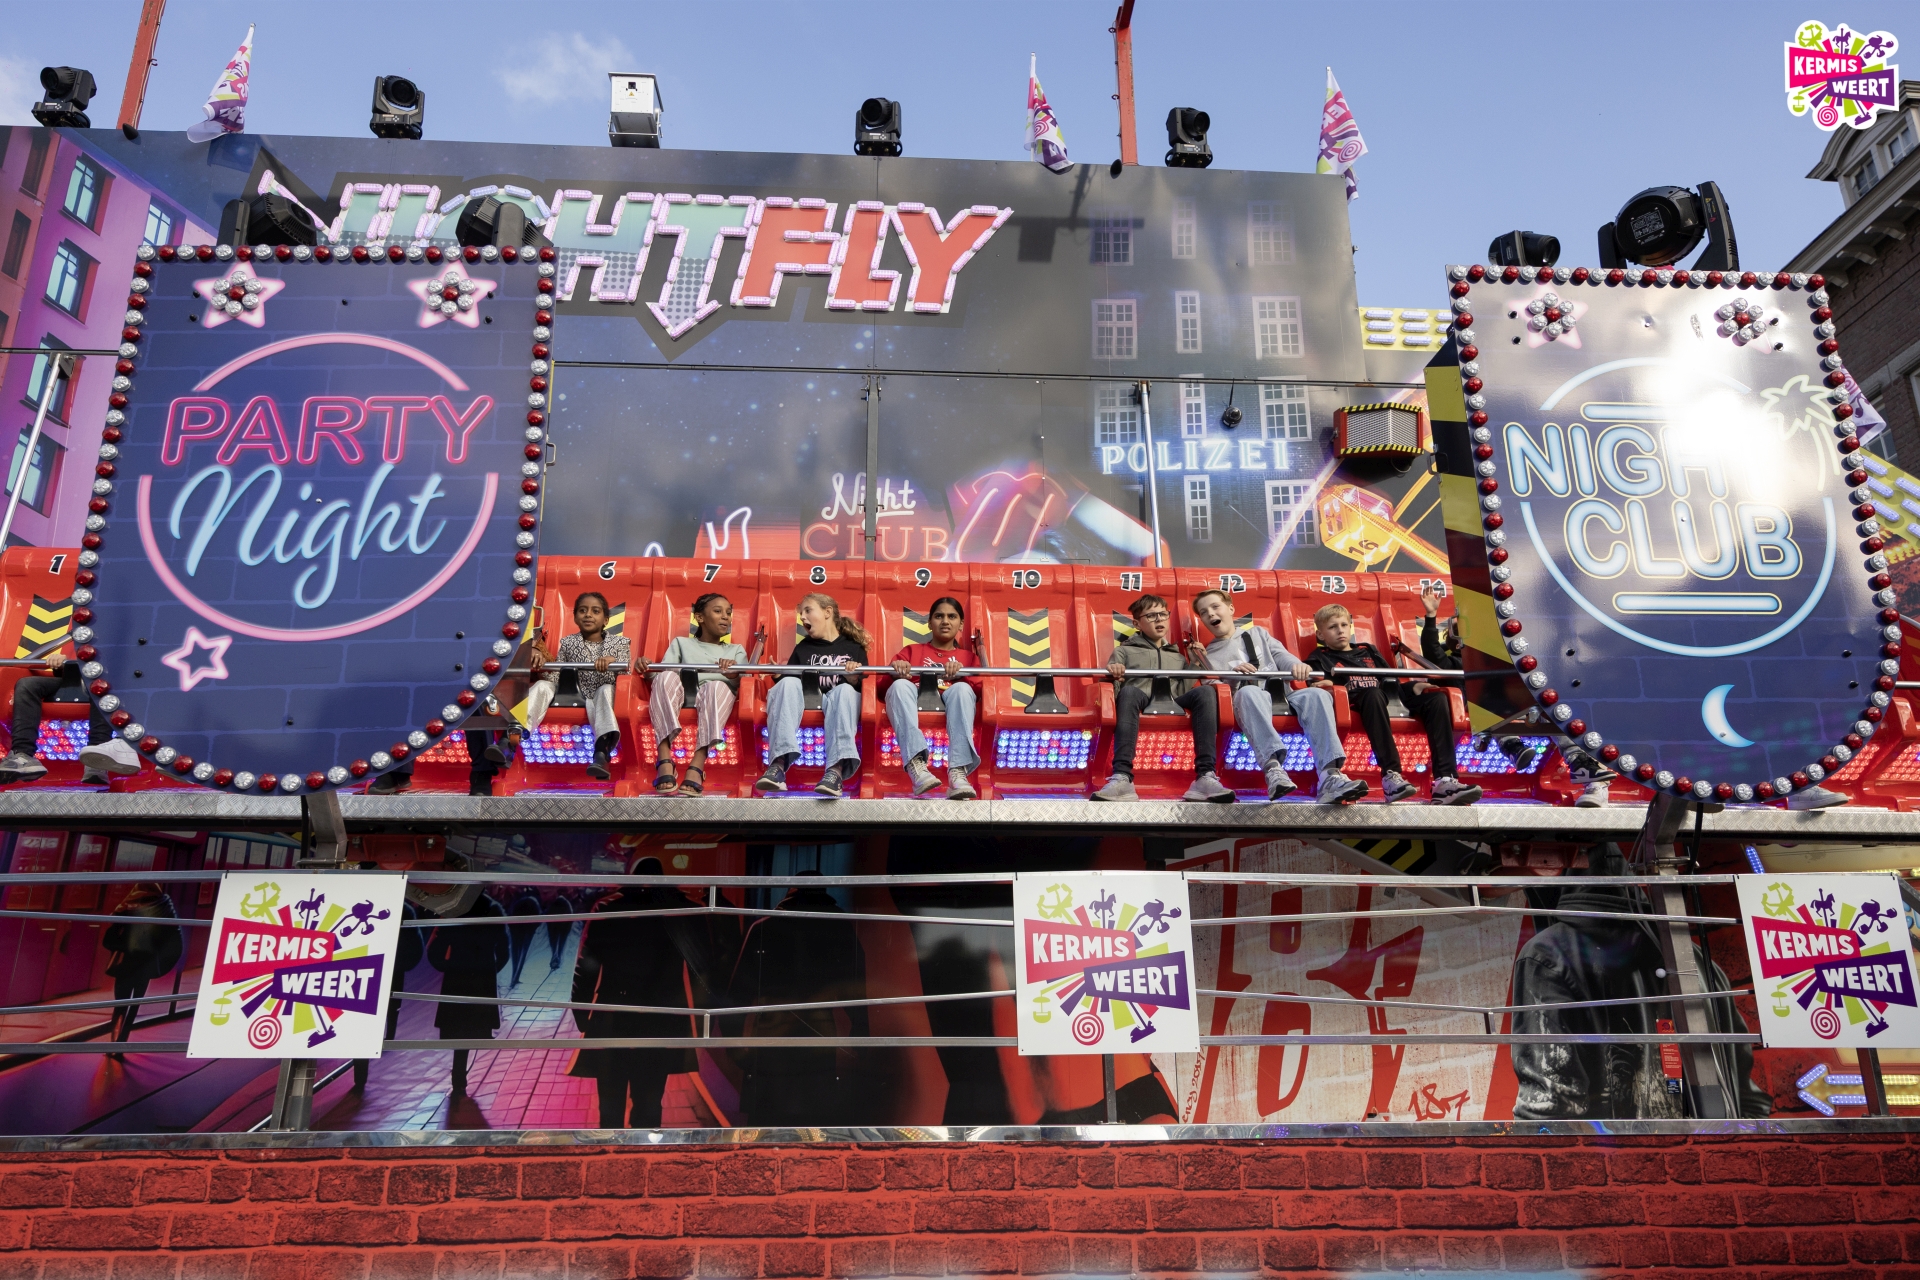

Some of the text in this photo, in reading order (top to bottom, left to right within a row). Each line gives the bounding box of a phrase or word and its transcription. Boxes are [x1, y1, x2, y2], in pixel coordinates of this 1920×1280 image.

[160, 394, 495, 467] PARTY
[1102, 439, 1291, 475] POLIZEI
[1503, 421, 1782, 499] NIGH
[821, 471, 917, 531] Niht
[169, 463, 446, 610] Night
[800, 521, 950, 562] CLUB
[1348, 539, 1379, 556] 16
[1563, 497, 1803, 580] CLUB
[48, 554, 68, 575] 1
[598, 561, 617, 581] 6
[703, 563, 723, 583] 7
[809, 565, 828, 586] 8
[914, 567, 932, 588] 9
[1012, 569, 1042, 590] 10
[1120, 572, 1143, 592] 11
[1219, 574, 1247, 594] 12
[1320, 575, 1347, 595] 13
[1420, 578, 1447, 598] 14
[222, 930, 331, 965] KERMIS
[1032, 931, 1131, 964] KERMIS
[1761, 929, 1855, 961] KERMIS
[281, 967, 376, 1001] WEERT
[1091, 965, 1180, 997] WEERT
[1821, 963, 1904, 994] WEERT
